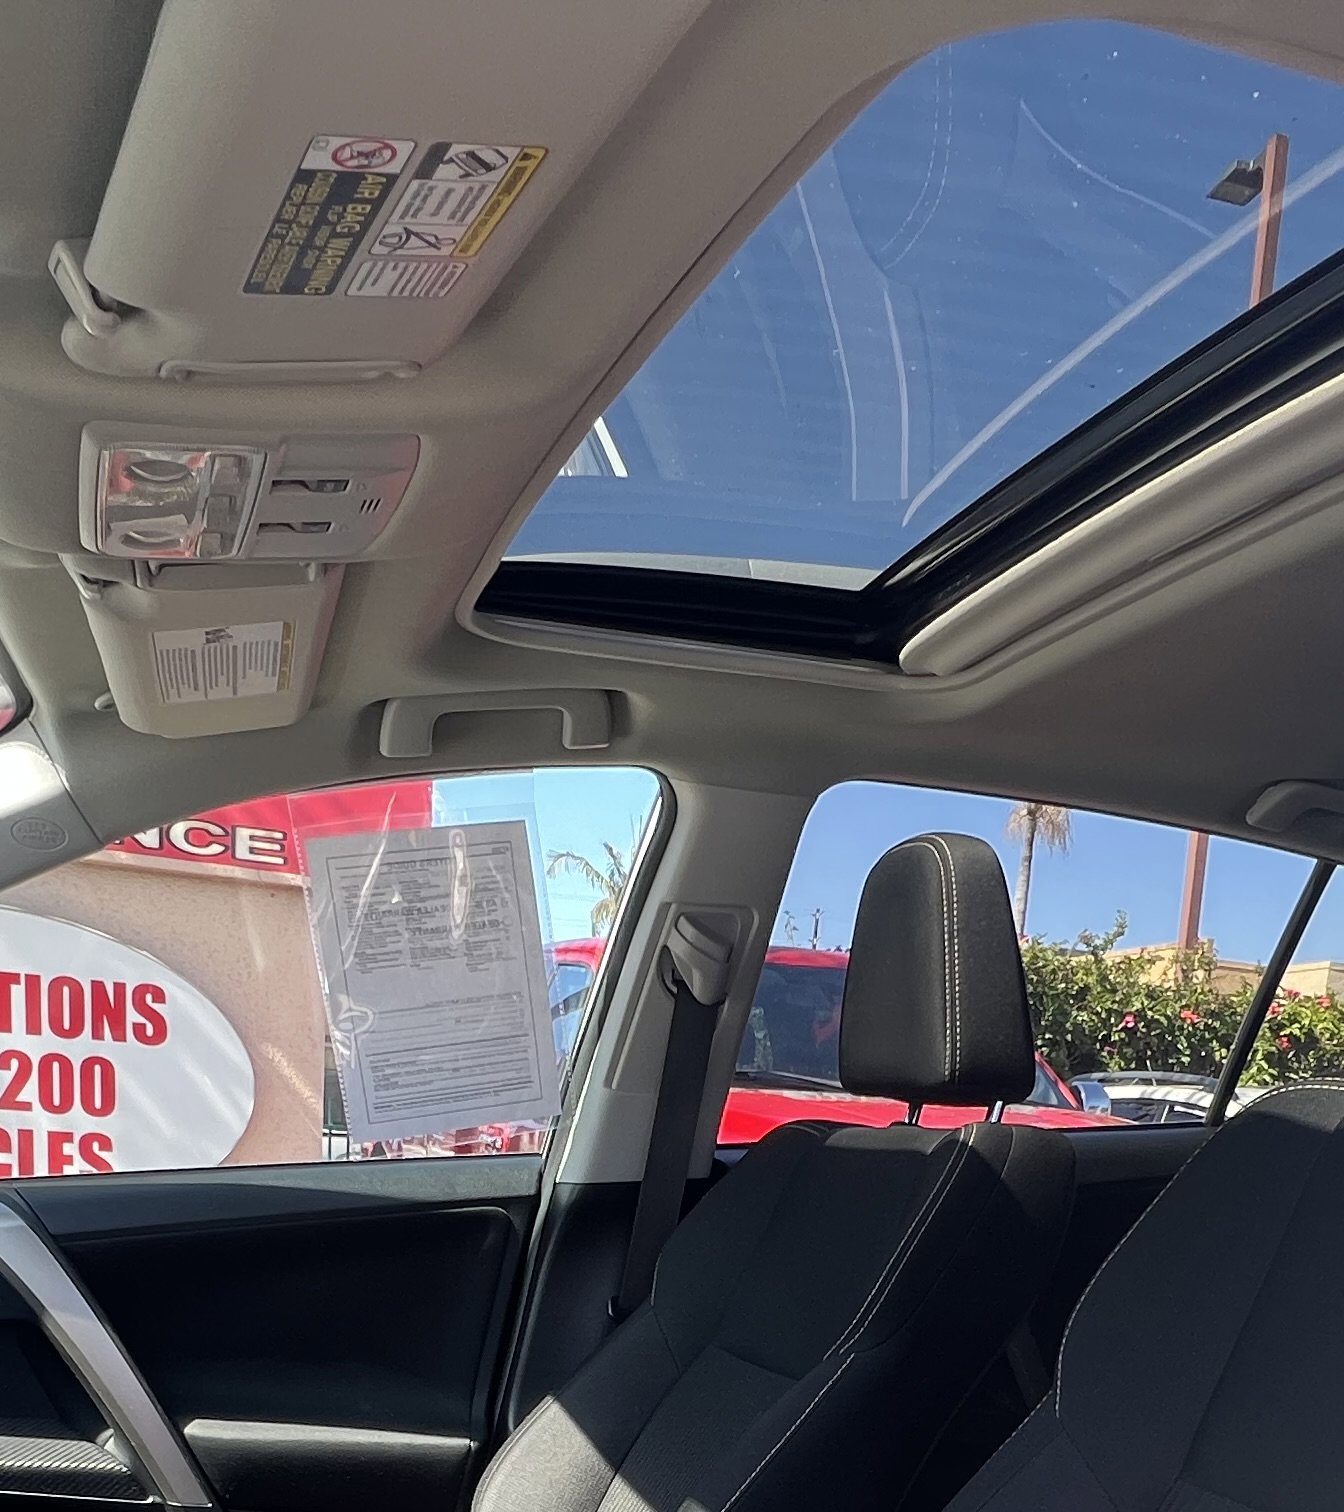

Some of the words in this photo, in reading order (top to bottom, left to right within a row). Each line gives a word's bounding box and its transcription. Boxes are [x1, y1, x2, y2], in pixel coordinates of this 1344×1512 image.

[354, 174, 387, 199] AIR
[335, 203, 372, 233] BAG
[304, 236, 353, 294] WARNING
